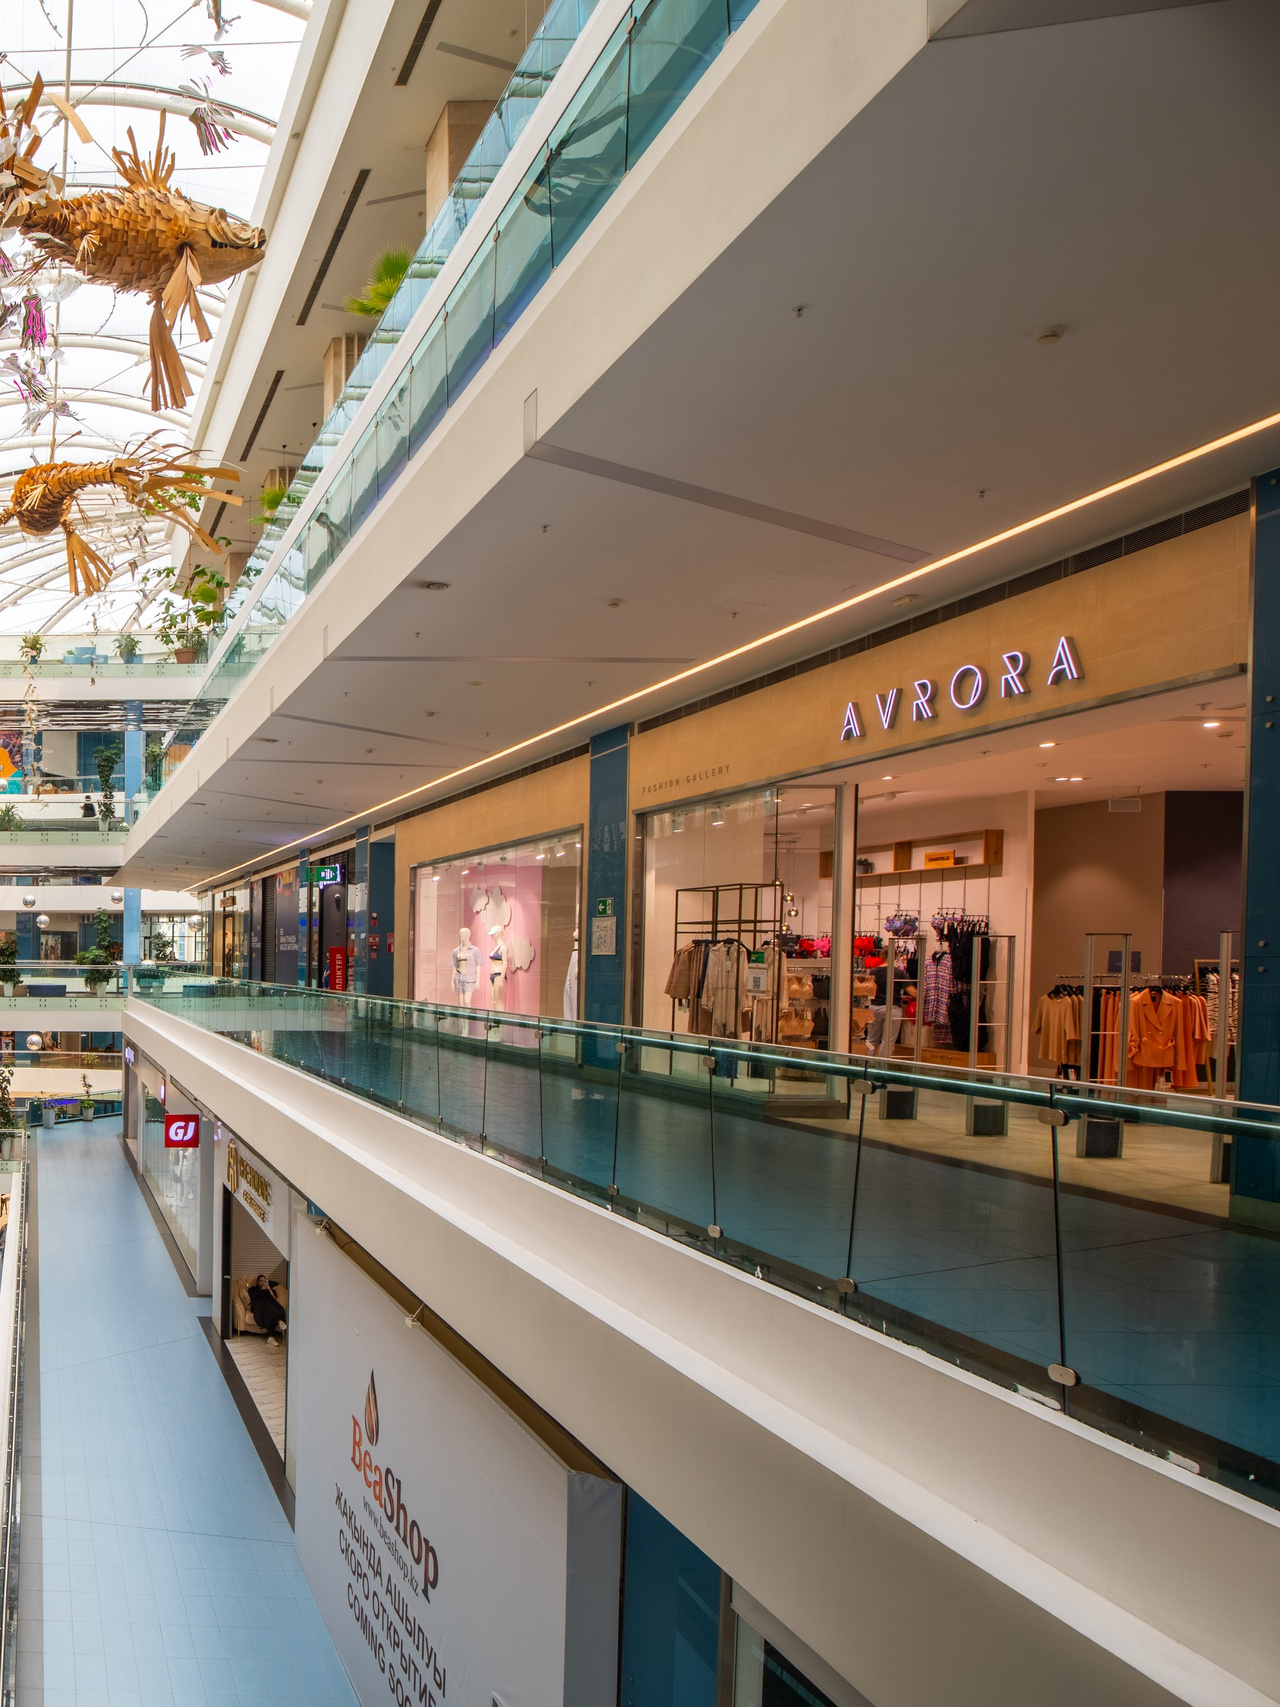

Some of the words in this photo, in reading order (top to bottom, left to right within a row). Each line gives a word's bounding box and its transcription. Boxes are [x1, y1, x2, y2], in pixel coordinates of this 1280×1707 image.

[840, 636, 1085, 741] AVRORA
[642, 778, 680, 795] FASHION
[686, 764, 730, 783] GALLERY
[168, 1121, 196, 1142] GJ
[351, 1414, 439, 1604] BeaShop
[363, 1496, 419, 1597] www.beashop.kz
[335, 1482, 384, 1587] ЖАҚЫНДА
[385, 1573, 447, 1699] АШЫЛУЫ
[339, 1529, 370, 1601] СКОРО
[347, 1583, 386, 1674] COMING
